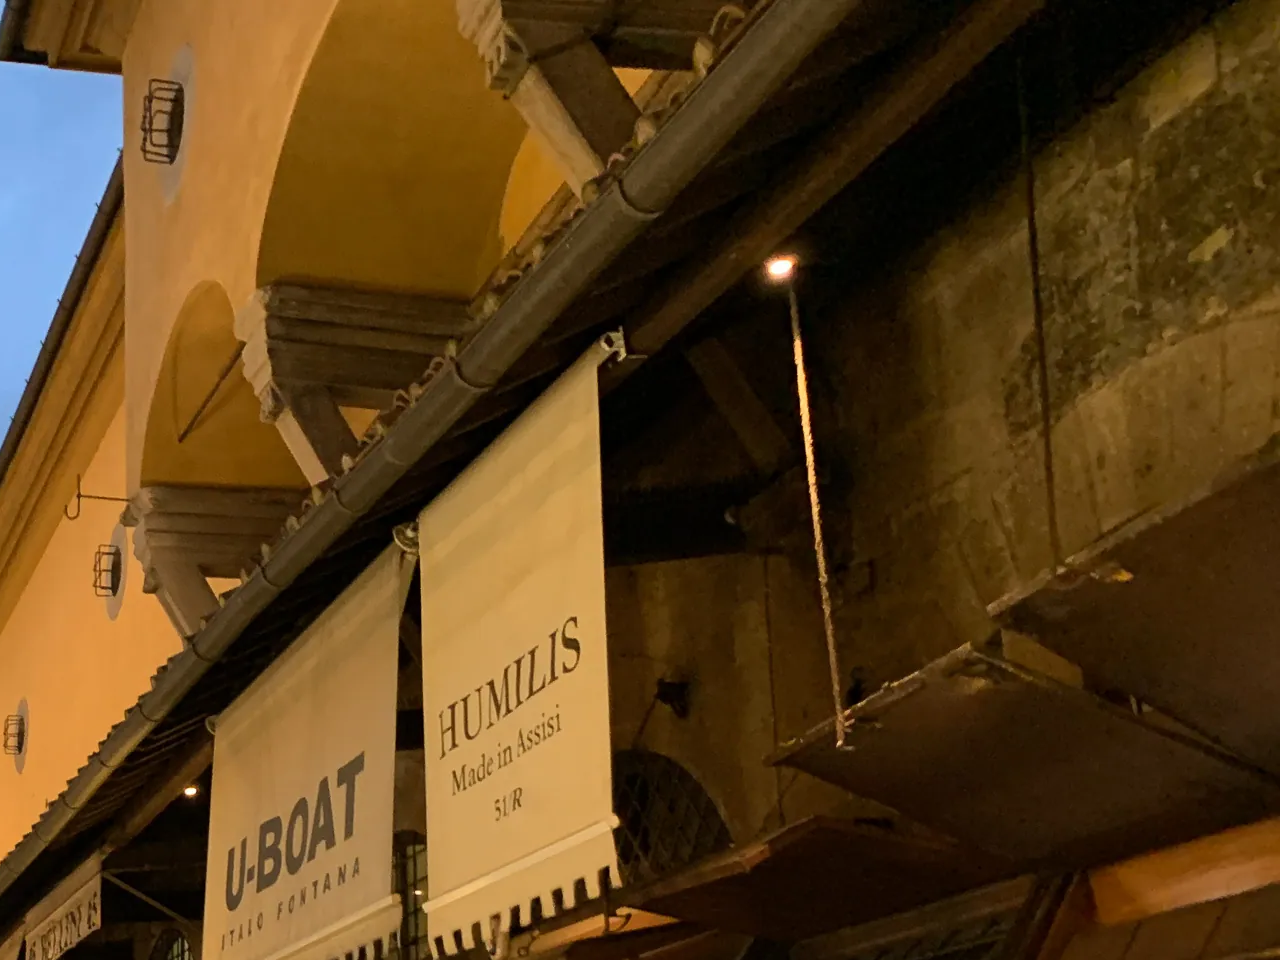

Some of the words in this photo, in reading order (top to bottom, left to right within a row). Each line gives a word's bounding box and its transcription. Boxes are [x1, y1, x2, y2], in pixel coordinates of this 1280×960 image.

[438, 616, 581, 760] HUMILIS
[451, 752, 493, 796] Made
[497, 742, 514, 770] in
[516, 704, 562, 757] Assisi
[225, 751, 365, 912] U-BOAT
[221, 912, 264, 951] ITALO
[276, 857, 360, 920] FONTANA
